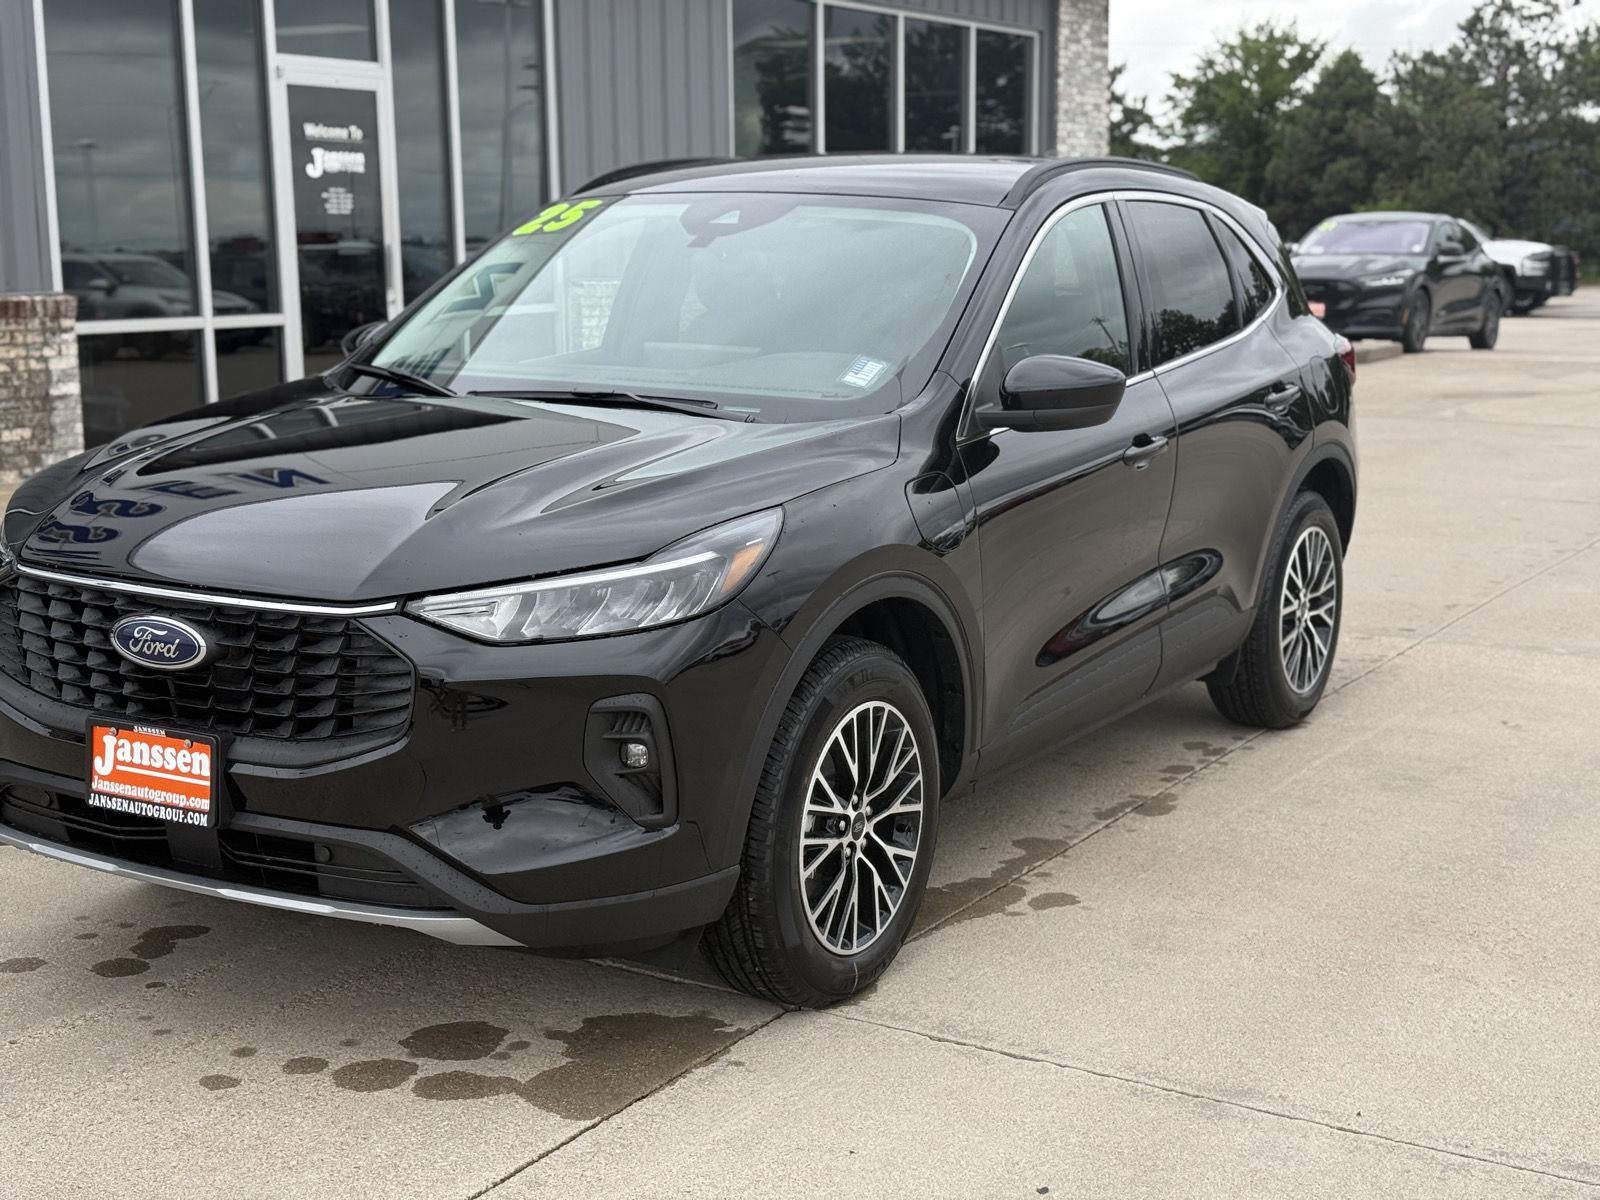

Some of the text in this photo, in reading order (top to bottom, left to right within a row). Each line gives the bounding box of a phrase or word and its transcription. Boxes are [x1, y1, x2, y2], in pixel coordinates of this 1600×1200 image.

[511, 199, 603, 236] 25
[129, 626, 180, 658] Ford
[94, 734, 211, 777] Janssen
[88, 792, 209, 827] JANSSENAUTOGROUP.COM
[91, 775, 211, 810] Janssenautogroup.com
